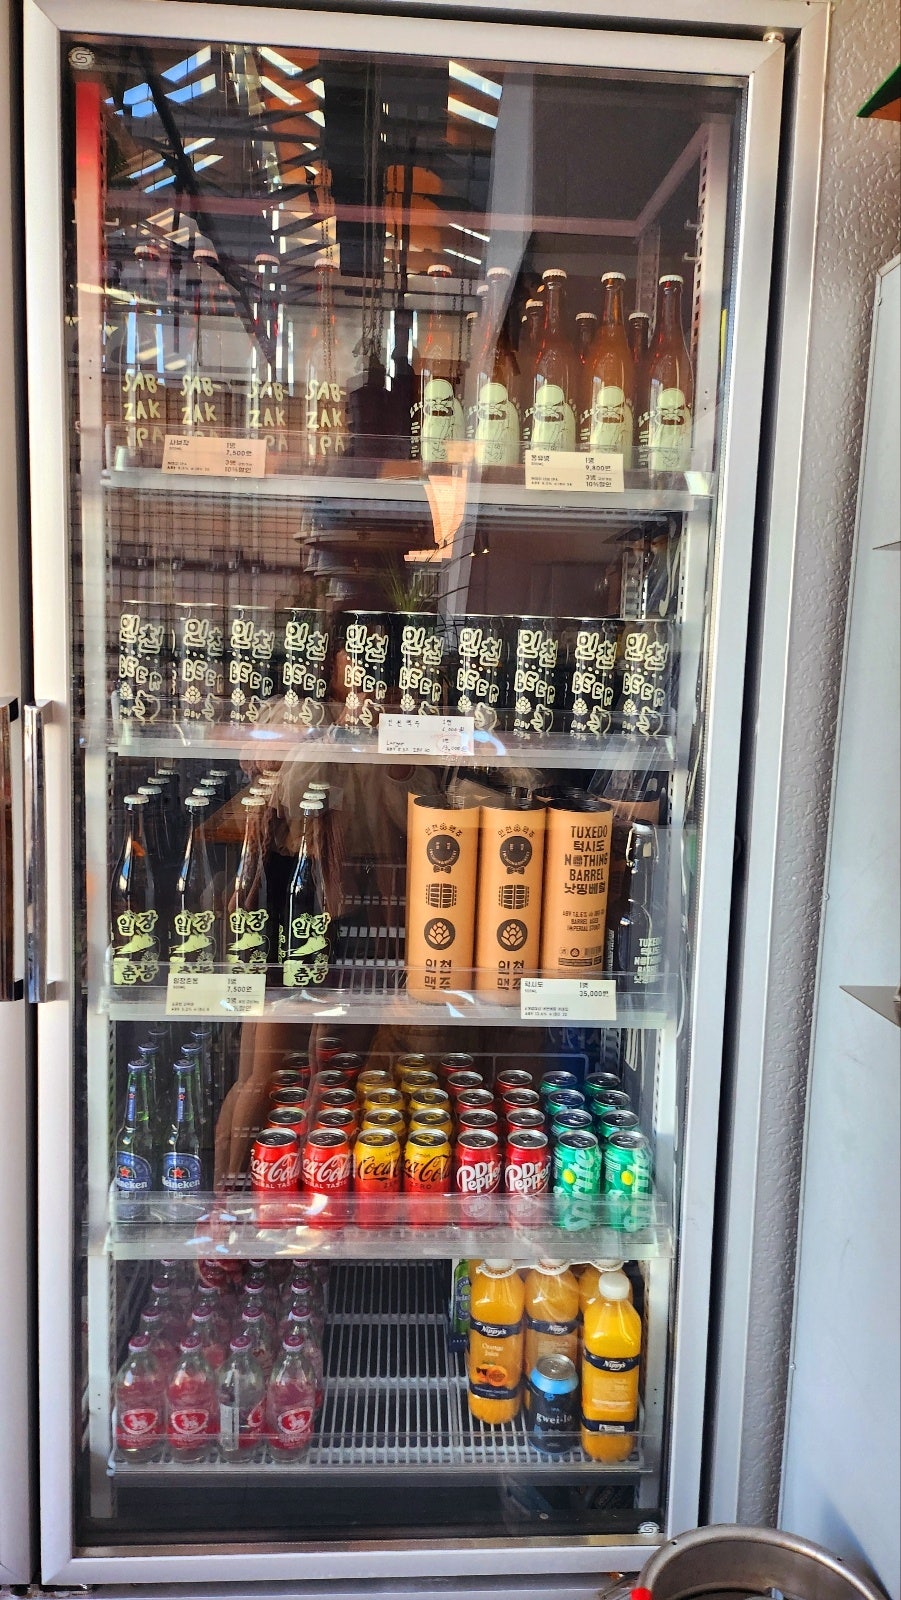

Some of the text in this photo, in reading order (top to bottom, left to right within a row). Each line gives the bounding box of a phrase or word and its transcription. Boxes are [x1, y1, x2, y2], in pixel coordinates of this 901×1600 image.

[305, 381, 347, 402] SAB-
[124, 399, 161, 422] ZAK
[182, 402, 218, 425] ZAK
[249, 408, 287, 429] ZAK
[306, 408, 343, 430] ZAK
[570, 824, 608, 839] TUXEDO
[573, 840, 605, 853] 턱시도
[569, 868, 604, 882] BARREL
[425, 958, 452, 974] 인천
[497, 959, 525, 975] 인천
[424, 975, 451, 990] 맥주
[536, 1412, 573, 1424] gwei-lo
